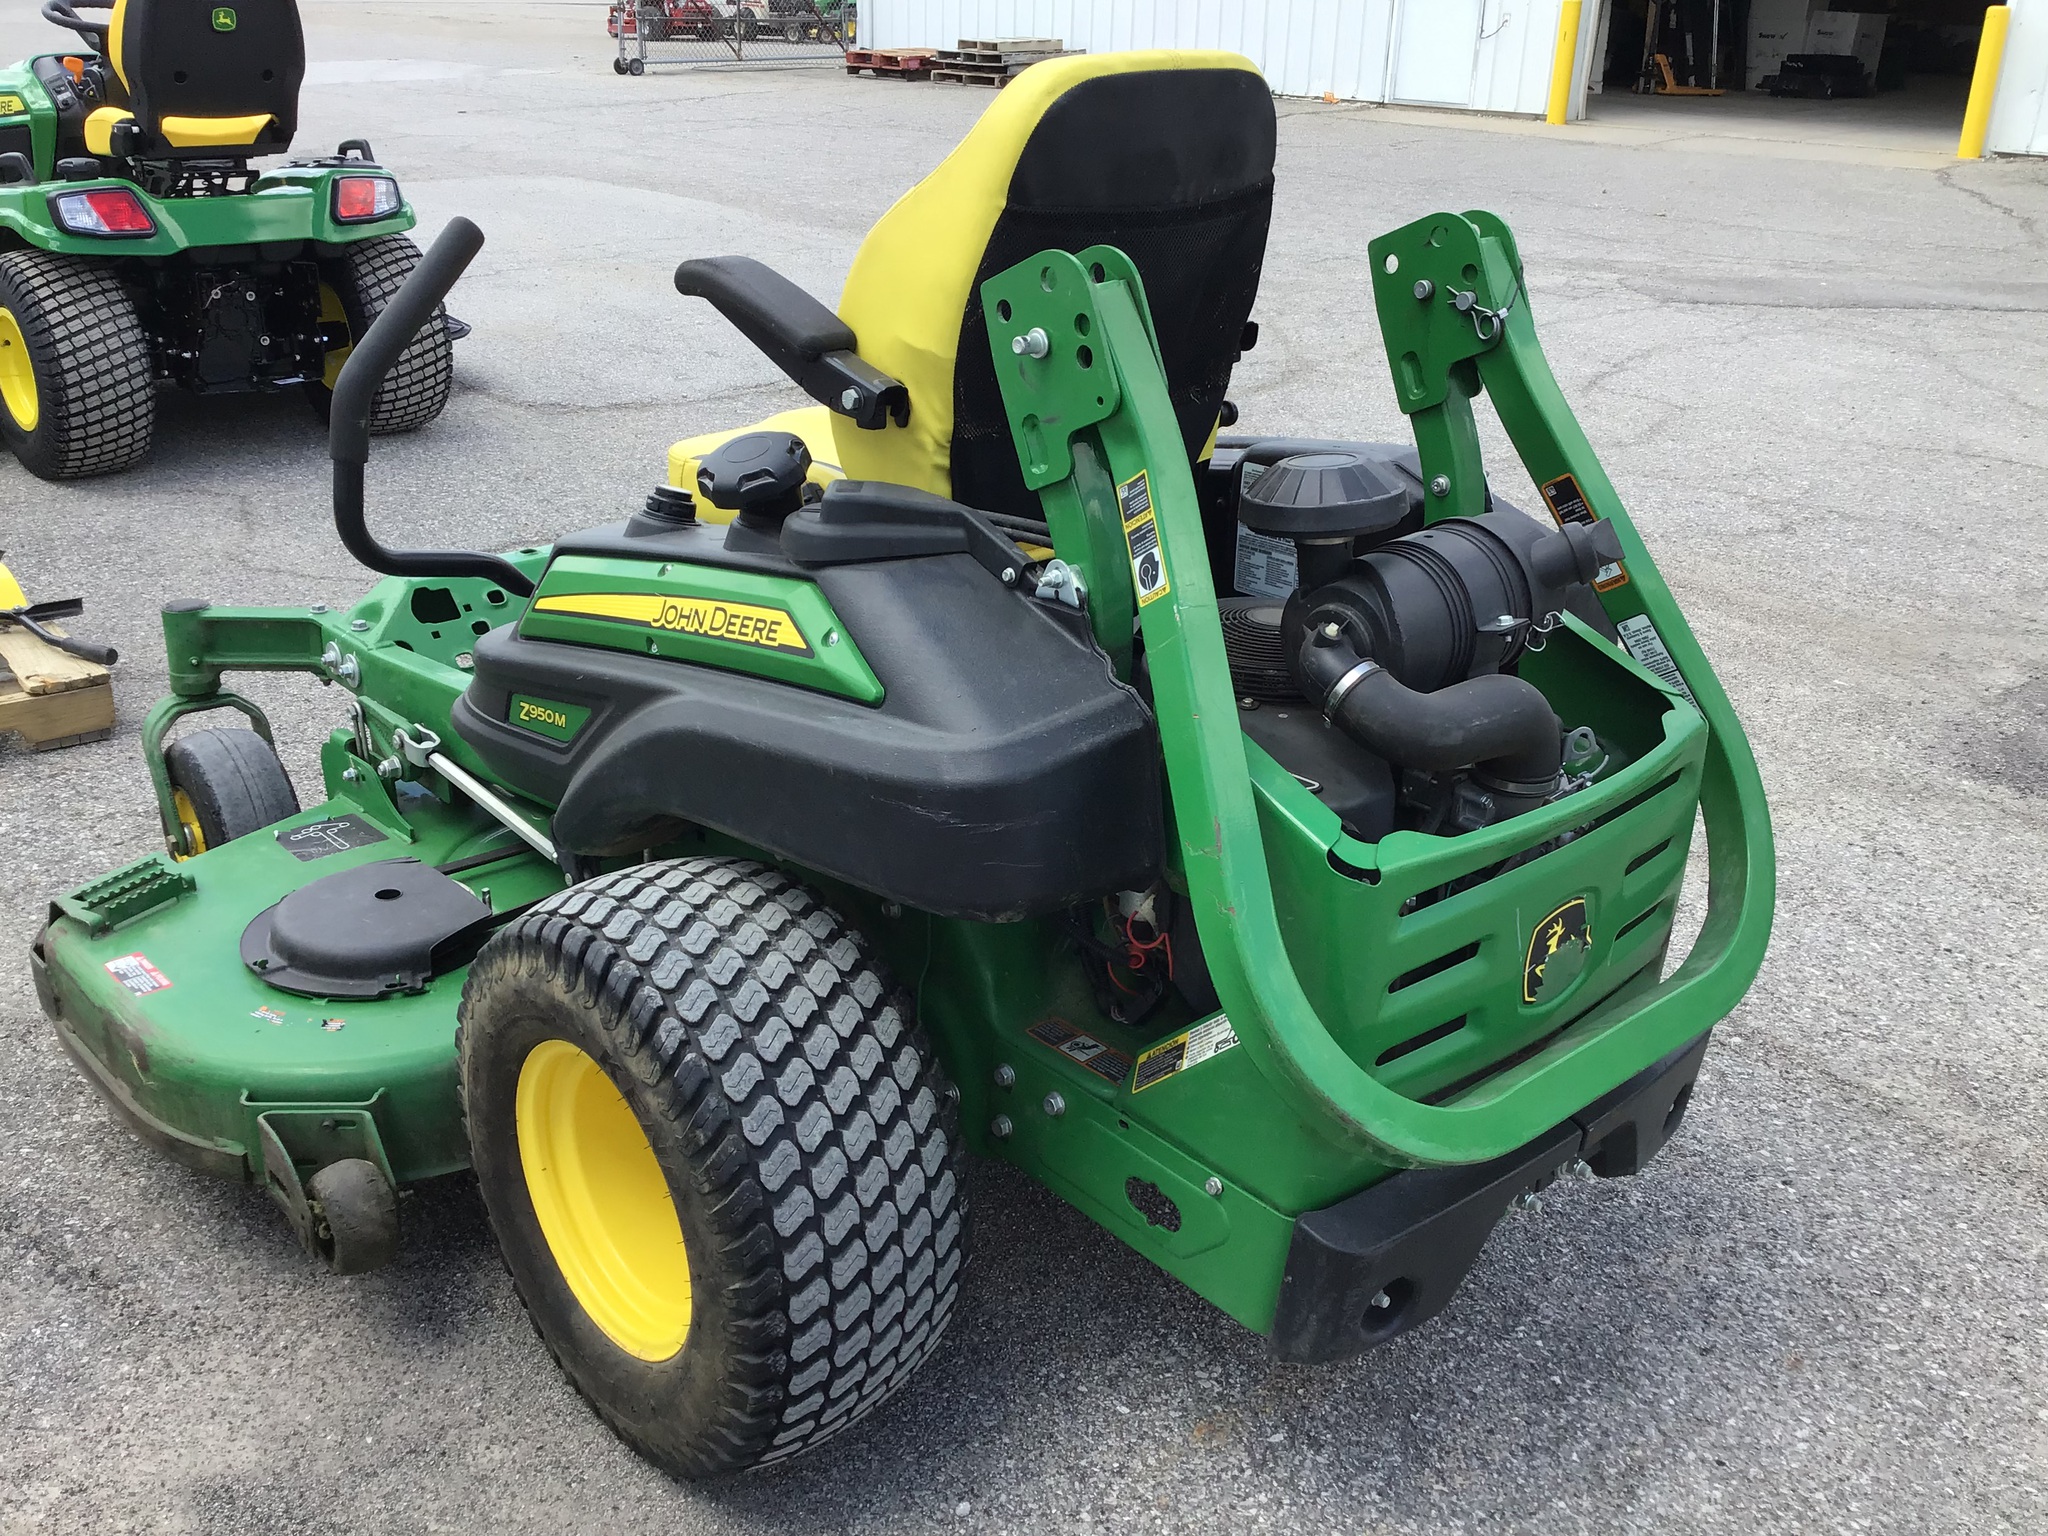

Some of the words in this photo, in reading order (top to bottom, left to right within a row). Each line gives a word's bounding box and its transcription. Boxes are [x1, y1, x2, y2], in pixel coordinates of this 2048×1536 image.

[652, 599, 707, 630] JOHN
[709, 606, 782, 642] DEERE
[519, 701, 566, 728] Z950M
